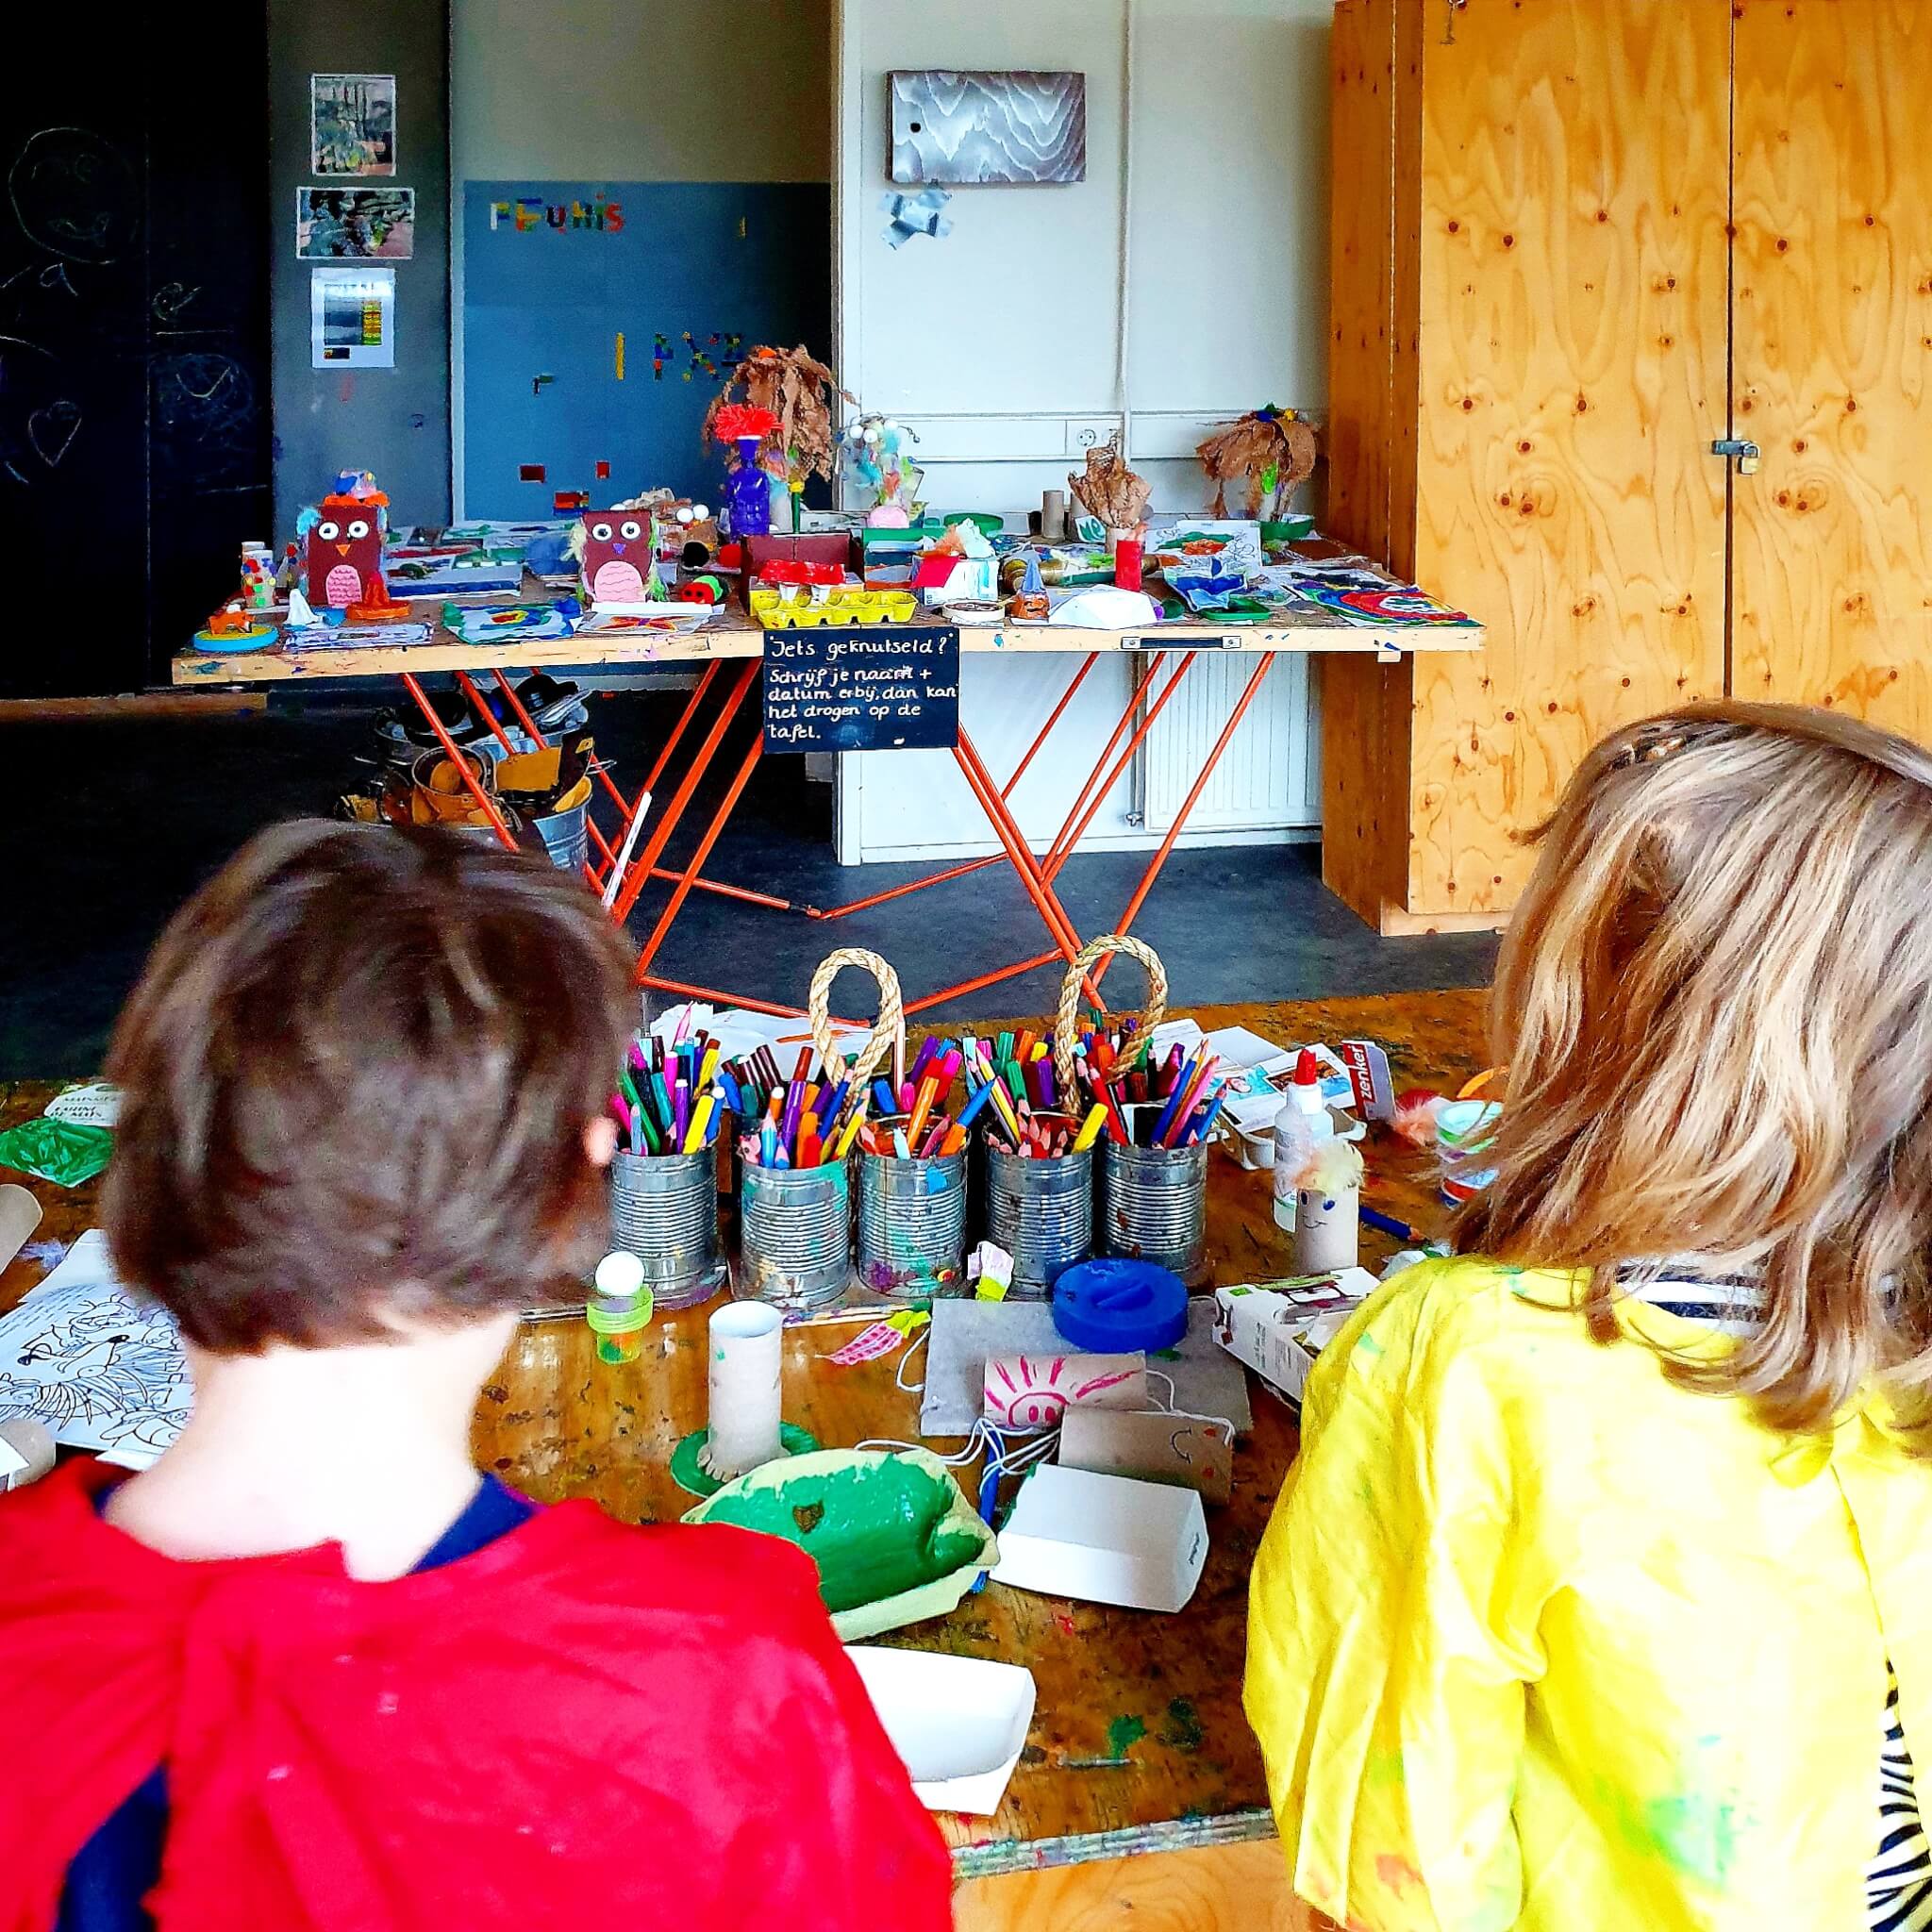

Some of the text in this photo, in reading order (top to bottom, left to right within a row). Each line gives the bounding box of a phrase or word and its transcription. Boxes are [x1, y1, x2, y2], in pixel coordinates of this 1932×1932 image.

[829, 668, 849, 688] je
[768, 687, 832, 701] datum
[926, 686, 957, 698] kan
[769, 704, 922, 722] het drogen op de
[769, 723, 822, 743] tafel.
[1346, 1044, 1373, 1100] zenker
